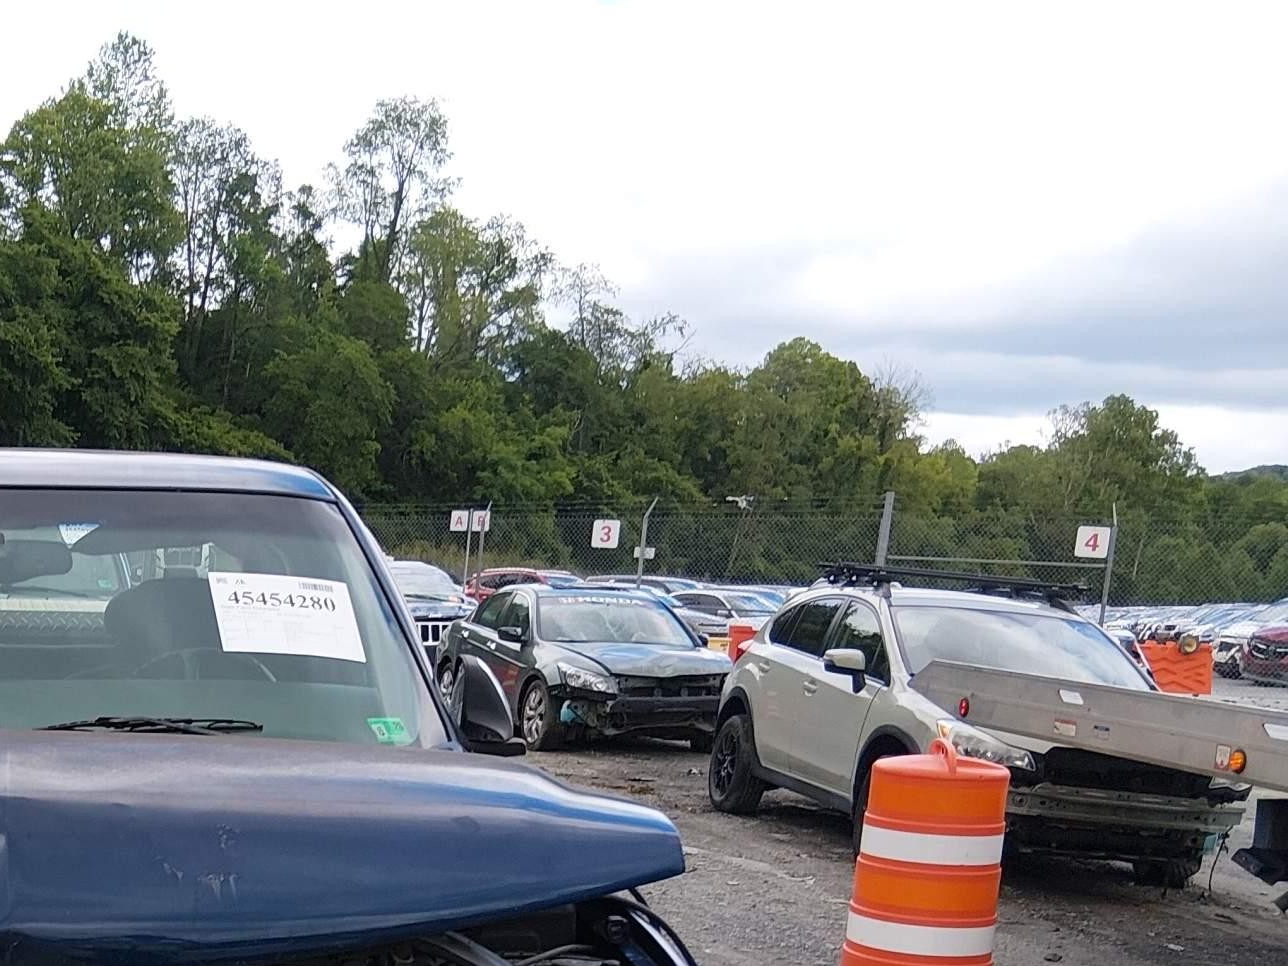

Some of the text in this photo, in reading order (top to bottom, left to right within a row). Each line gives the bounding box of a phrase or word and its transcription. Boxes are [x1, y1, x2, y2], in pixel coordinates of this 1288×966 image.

[455, 515, 463, 528] A
[599, 526, 613, 543] 3
[1084, 533, 1100, 552] 4
[227, 590, 336, 612] 45454280
